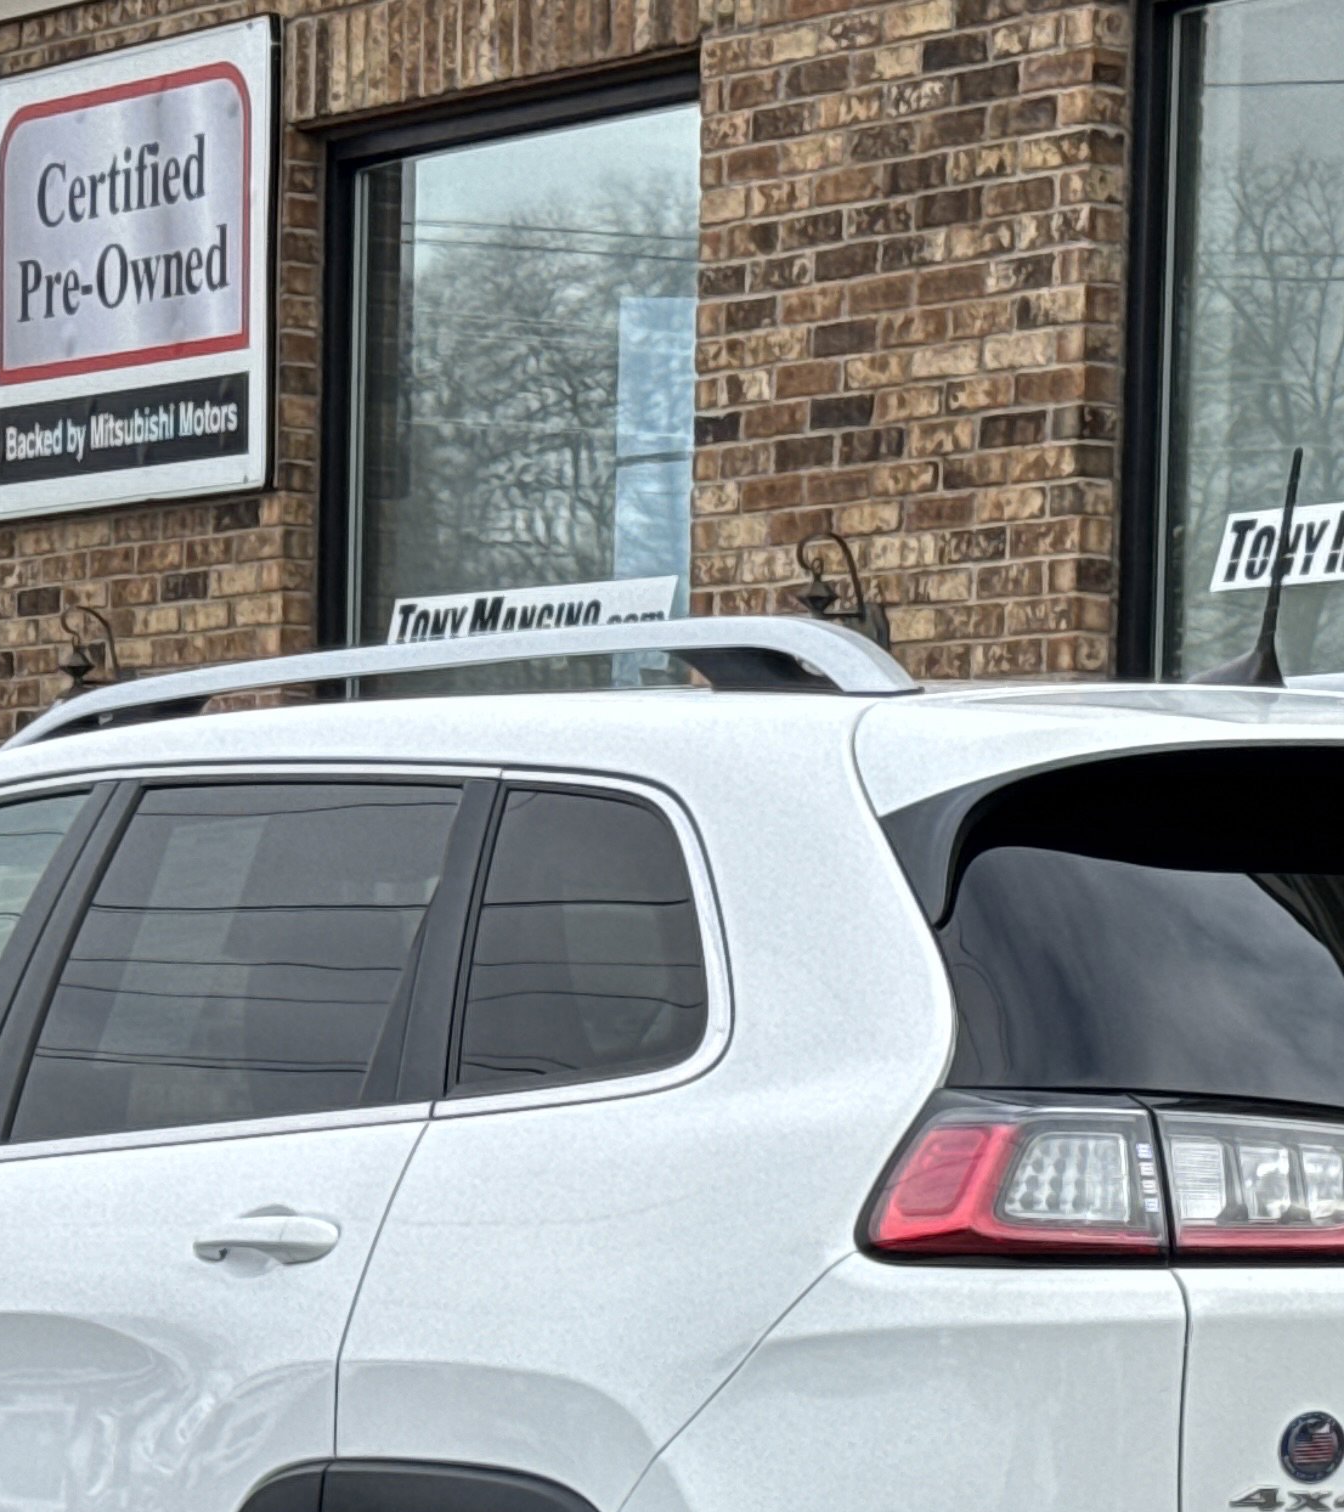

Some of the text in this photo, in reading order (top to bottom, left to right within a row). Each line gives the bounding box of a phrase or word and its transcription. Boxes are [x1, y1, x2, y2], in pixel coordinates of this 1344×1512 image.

[37, 133, 205, 228] Certified
[17, 223, 229, 323] Pre-Owned
[5, 400, 238, 463] Backed by Mitsubishi Motors
